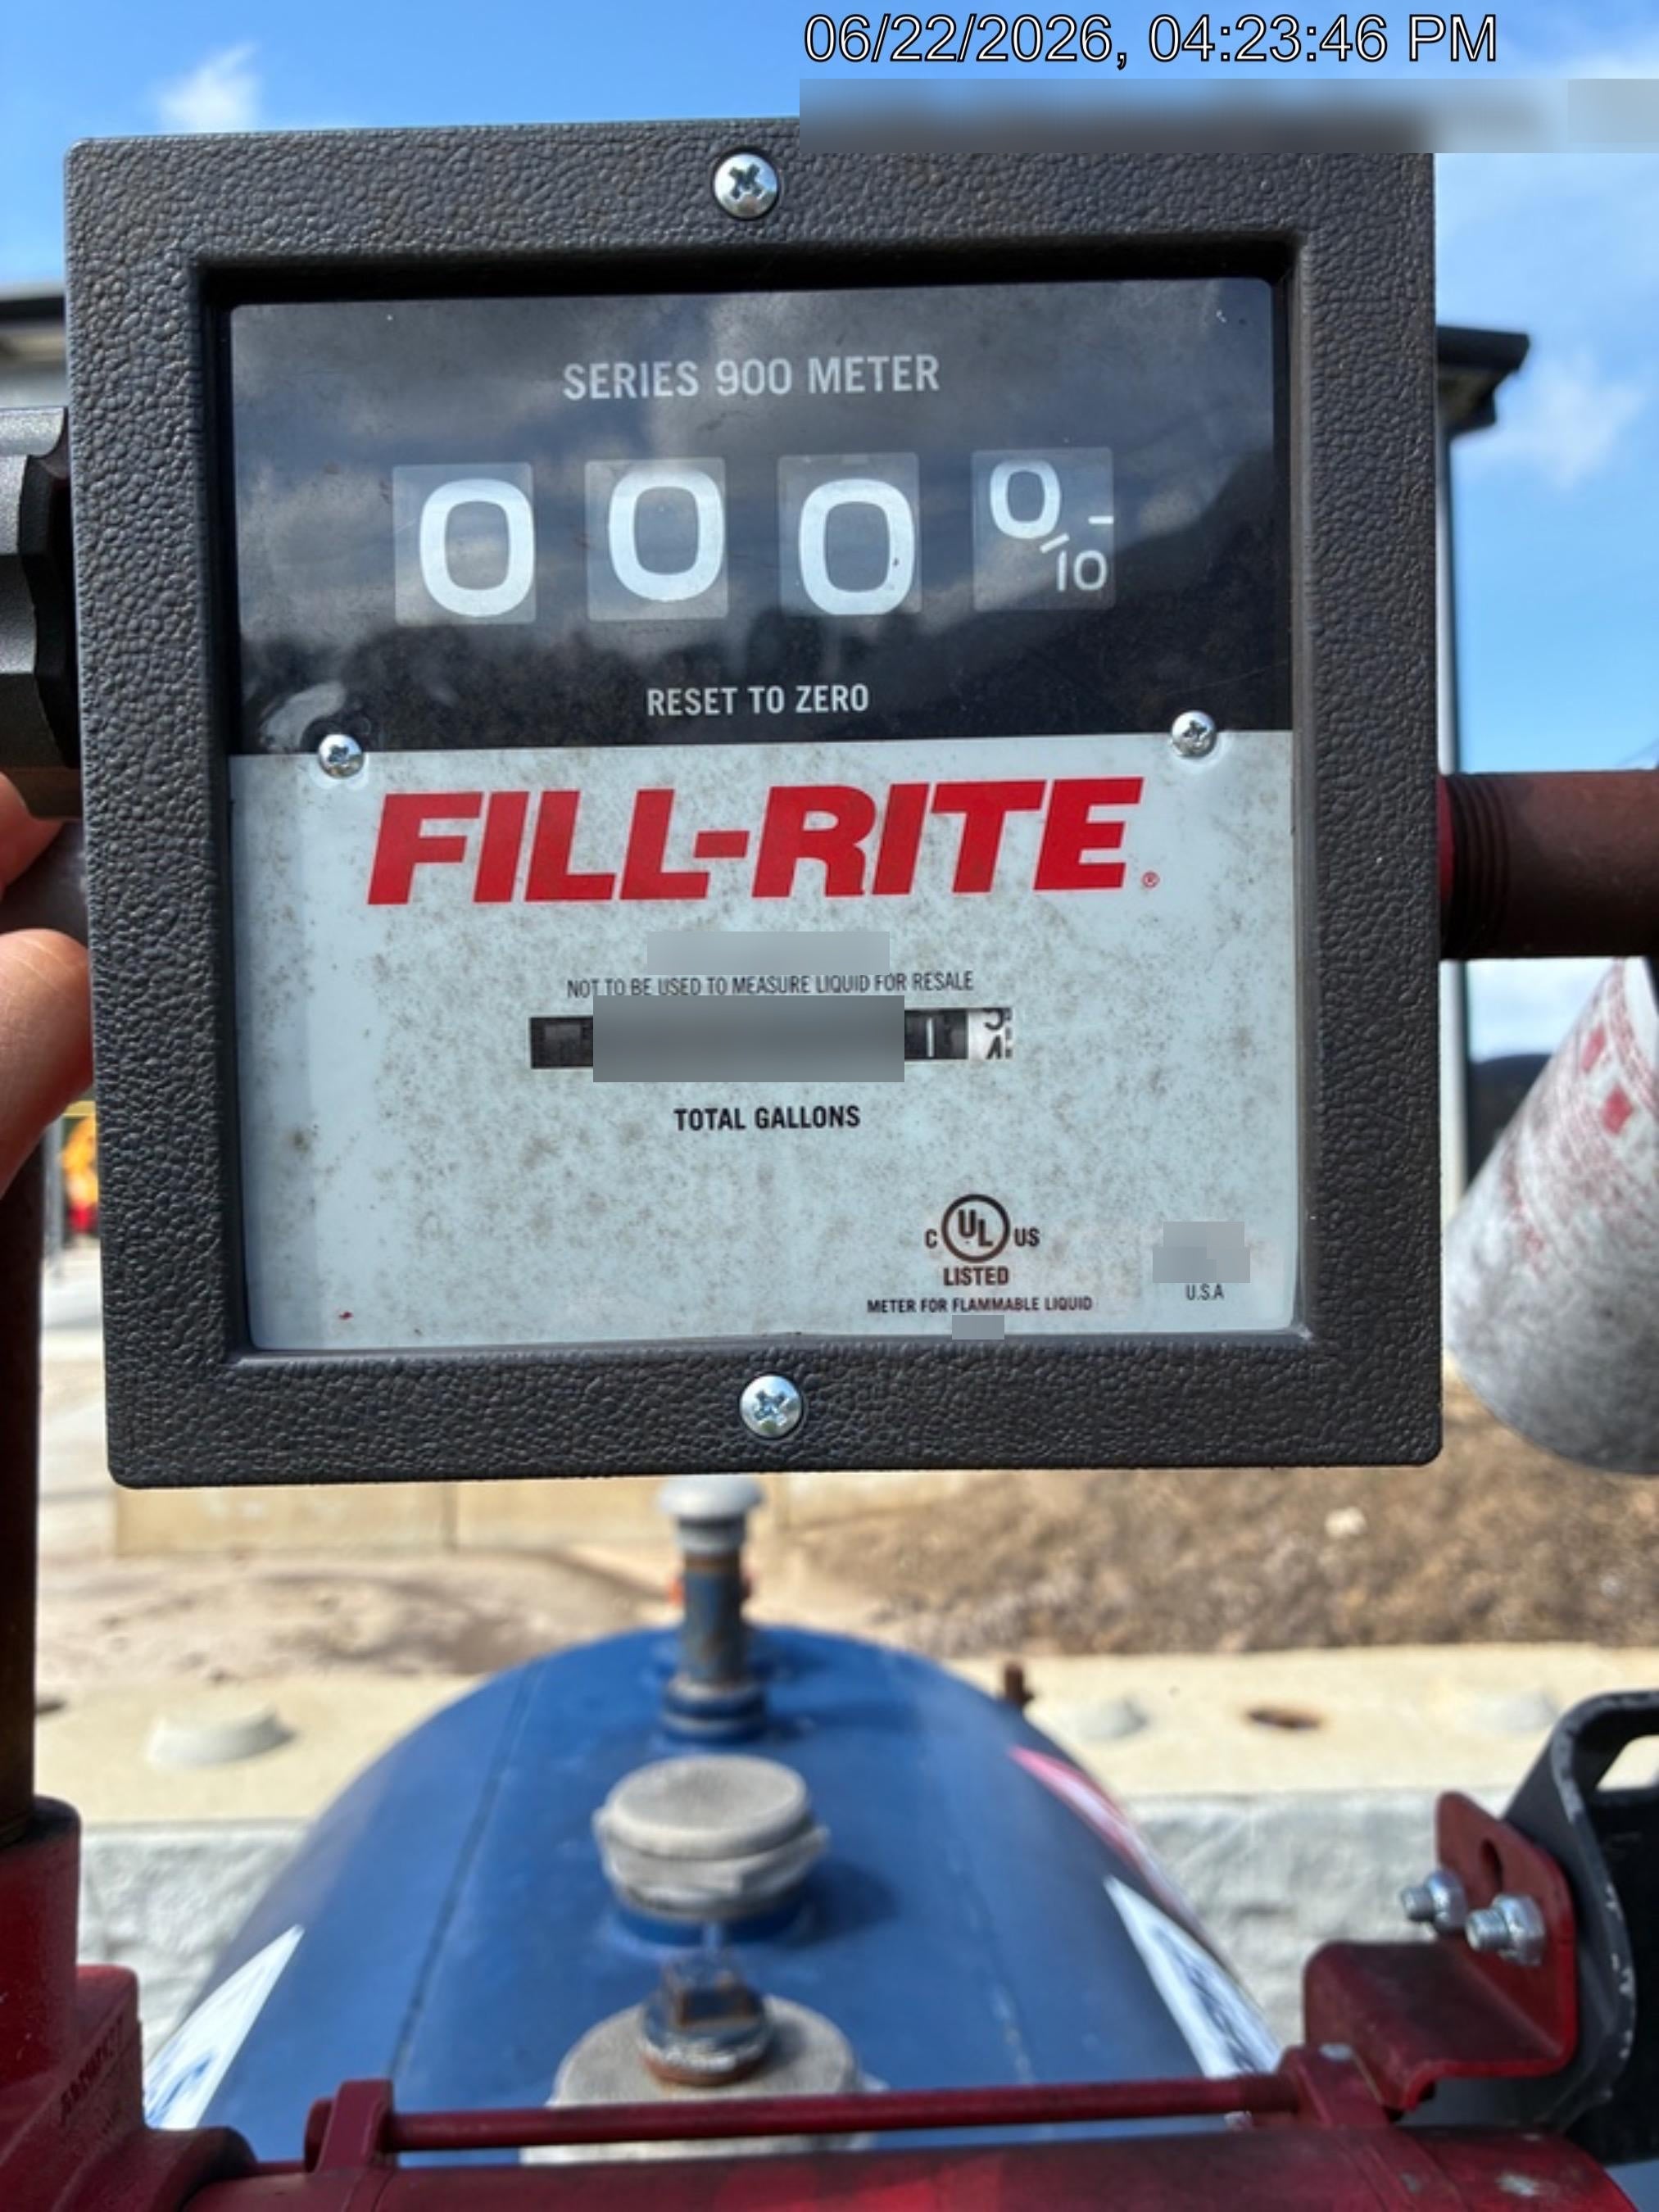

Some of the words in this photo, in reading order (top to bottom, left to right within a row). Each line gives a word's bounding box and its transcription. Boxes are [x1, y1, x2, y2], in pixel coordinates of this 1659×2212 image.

[563, 361, 700, 400] SERIES
[716, 359, 792, 396] 900
[807, 356, 940, 393] METER
[646, 687, 738, 717] RESET
[748, 687, 786, 714] TO
[796, 684, 869, 713] ZERO
[367, 777, 1144, 905] FILL-RITE
[567, 979, 598, 998] NOT
[605, 978, 625, 996] TO
[631, 977, 652, 995] BE
[658, 977, 700, 995] USED
[708, 977, 728, 995] TO
[732, 975, 810, 995] MEASURE
[816, 975, 870, 993] LIQUID
[875, 973, 907, 992] FOR
[913, 971, 973, 990] RESALE
[673, 1108, 746, 1131] TOTAL
[755, 1105, 860, 1129] GALLONS
[958, 1209, 993, 1247] UL
[1015, 1228, 1040, 1247] US
[943, 1267, 1009, 1286] LISTED
[867, 1299, 915, 1312] METER
[921, 1299, 947, 1312] FOR
[952, 1298, 1039, 1311] FLAMMABLE
[1045, 1296, 1092, 1310] LIQUID
